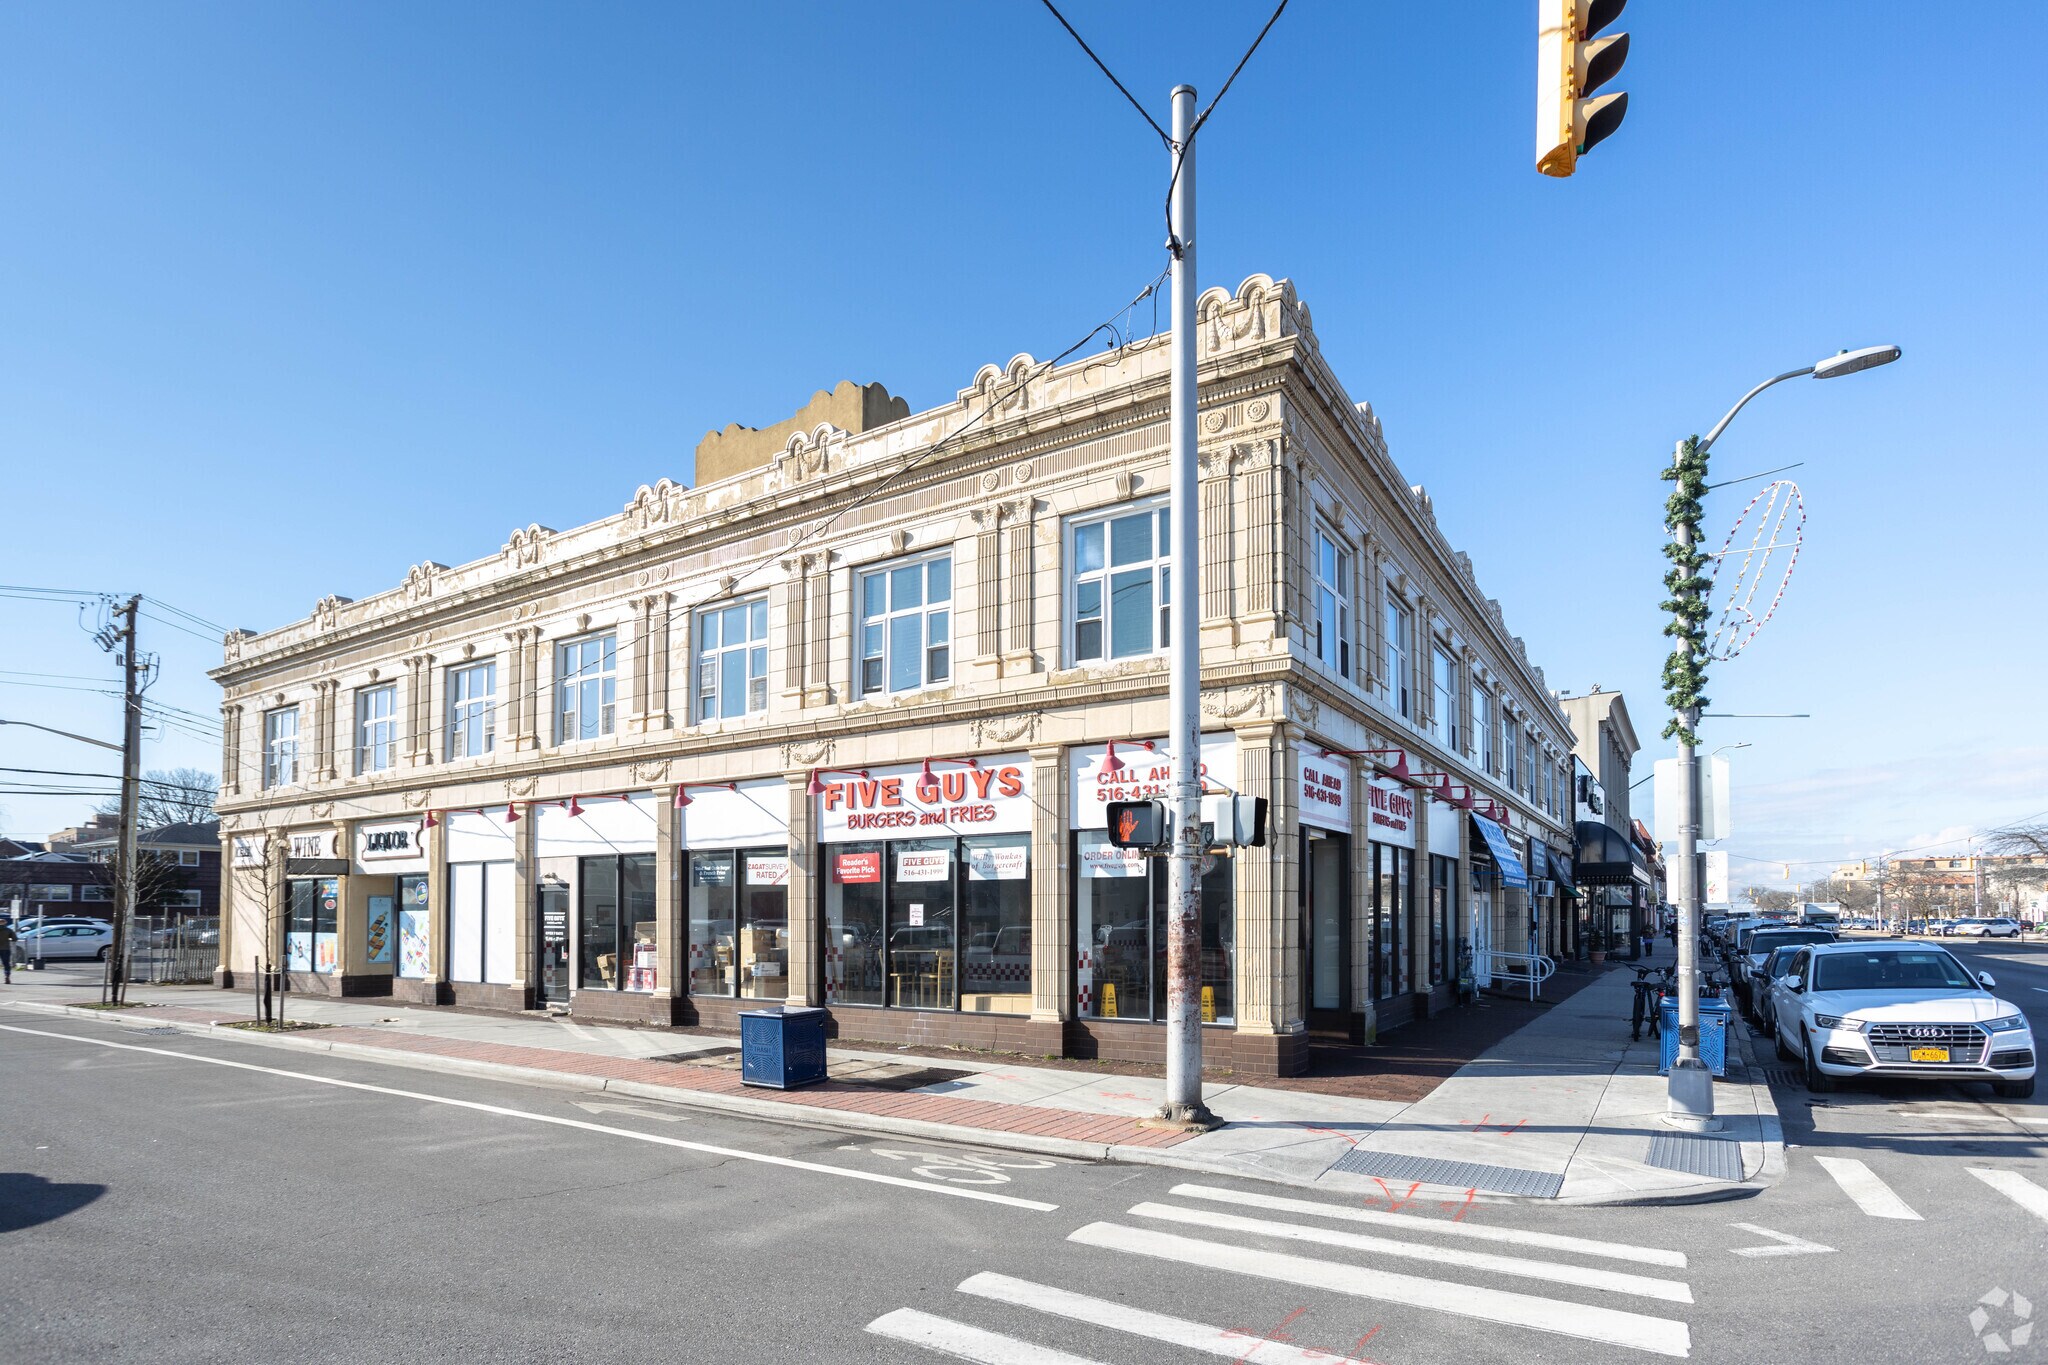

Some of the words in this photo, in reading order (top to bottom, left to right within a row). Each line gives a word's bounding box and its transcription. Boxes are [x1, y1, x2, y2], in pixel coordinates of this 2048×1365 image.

[1097, 769, 1139, 785] CALL
[1149, 763, 1207, 781] AHD
[1304, 766, 1320, 784] CALL
[825, 777, 902, 811] FIVE
[916, 766, 1024, 804] GUYS
[1389, 792, 1413, 820] GUYS
[847, 810, 917, 830] BURGERS
[919, 808, 946, 826] and
[950, 804, 996, 823] FRIES
[294, 836, 322, 857] WINE
[367, 831, 409, 852] LIQUOR
[842, 858, 869, 866] Reader's
[903, 858, 922, 866] FIVE
[924, 857, 945, 865] GUYS
[1084, 850, 1114, 861] ORDER
[1116, 849, 1140, 860] ONLIN
[755, 871, 778, 879] RATED
[836, 866, 861, 875] Favorite
[861, 865, 876, 874] Pick
